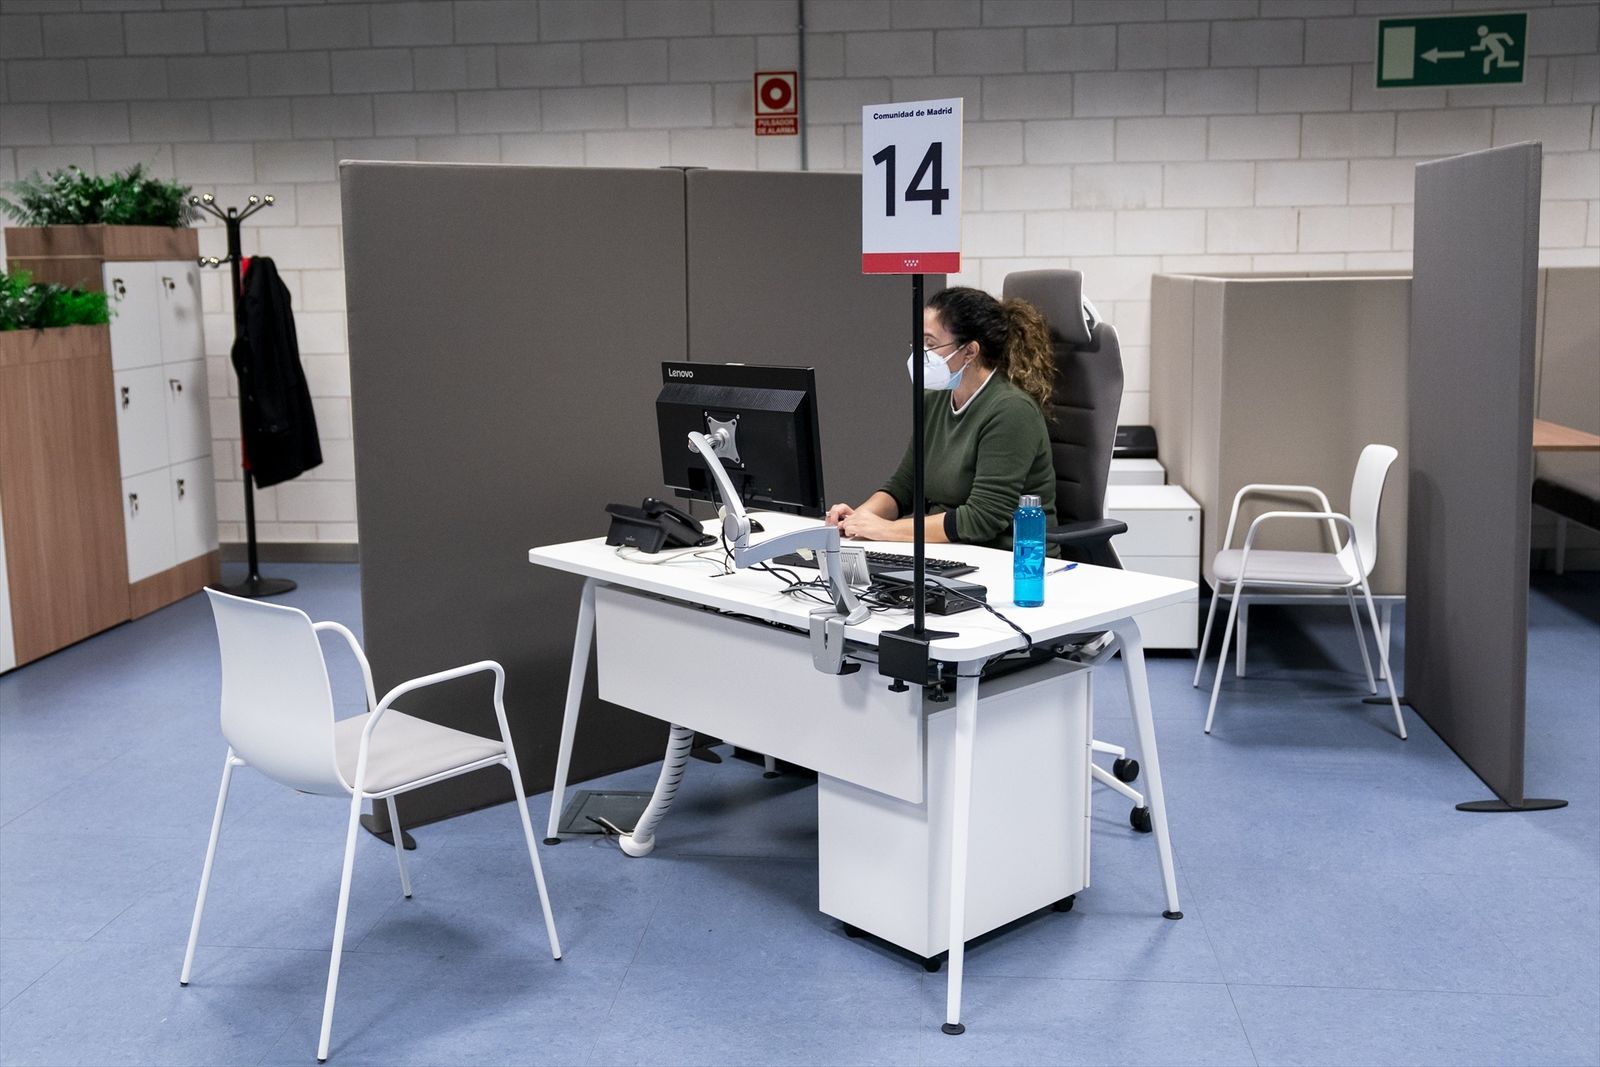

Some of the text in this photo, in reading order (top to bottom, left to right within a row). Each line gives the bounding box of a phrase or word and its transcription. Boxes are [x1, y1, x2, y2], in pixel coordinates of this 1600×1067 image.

[873, 111, 914, 120] Comunidad
[926, 107, 953, 116] Madrid
[872, 142, 949, 216] 14
[668, 367, 694, 378] Lenovo
